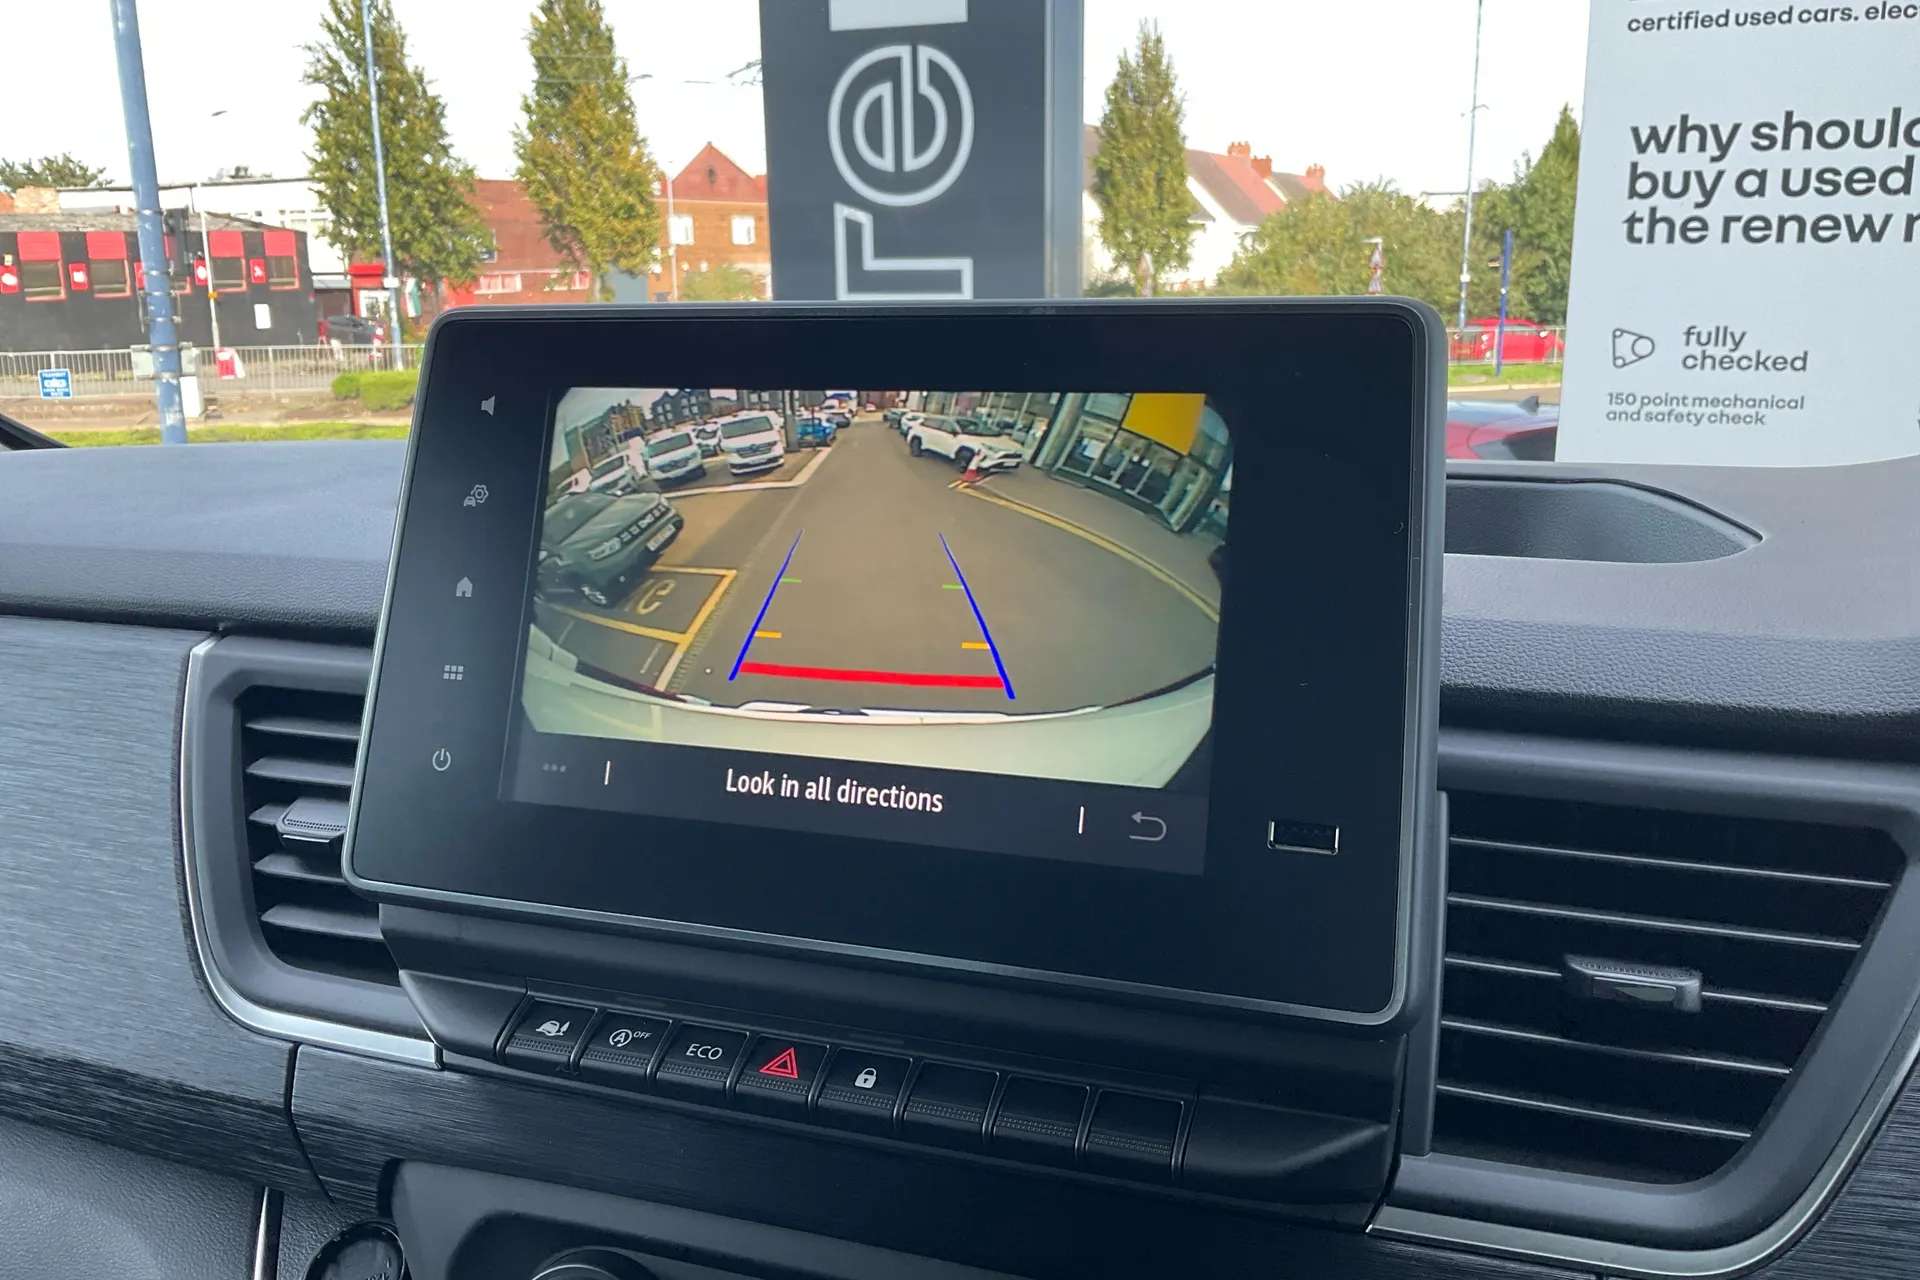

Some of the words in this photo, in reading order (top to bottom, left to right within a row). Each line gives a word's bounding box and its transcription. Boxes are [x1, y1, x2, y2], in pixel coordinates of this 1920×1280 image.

[1627, 9, 1730, 32] certified
[1734, 6, 1794, 27] used
[1797, 5, 1859, 24] cars.
[1630, 113, 1743, 163] why
[1627, 161, 1726, 209] buy
[1734, 168, 1768, 198] a
[1781, 154, 1915, 198] used
[1622, 206, 1709, 244] the
[1720, 213, 1894, 244] renew
[1682, 325, 1747, 351] fully
[1681, 349, 1809, 372] checked
[1607, 391, 1637, 406] 150
[1639, 392, 1689, 410] point
[1691, 393, 1805, 410] mechanical
[1606, 408, 1640, 422] and
[1643, 408, 1704, 426] safety
[1707, 410, 1768, 426] check
[725, 768, 775, 797] Look
[780, 773, 800, 798] in
[804, 776, 832, 802] all
[836, 778, 944, 813] directions
[633, 1030, 653, 1040] OFF
[685, 1043, 723, 1061] ECO
